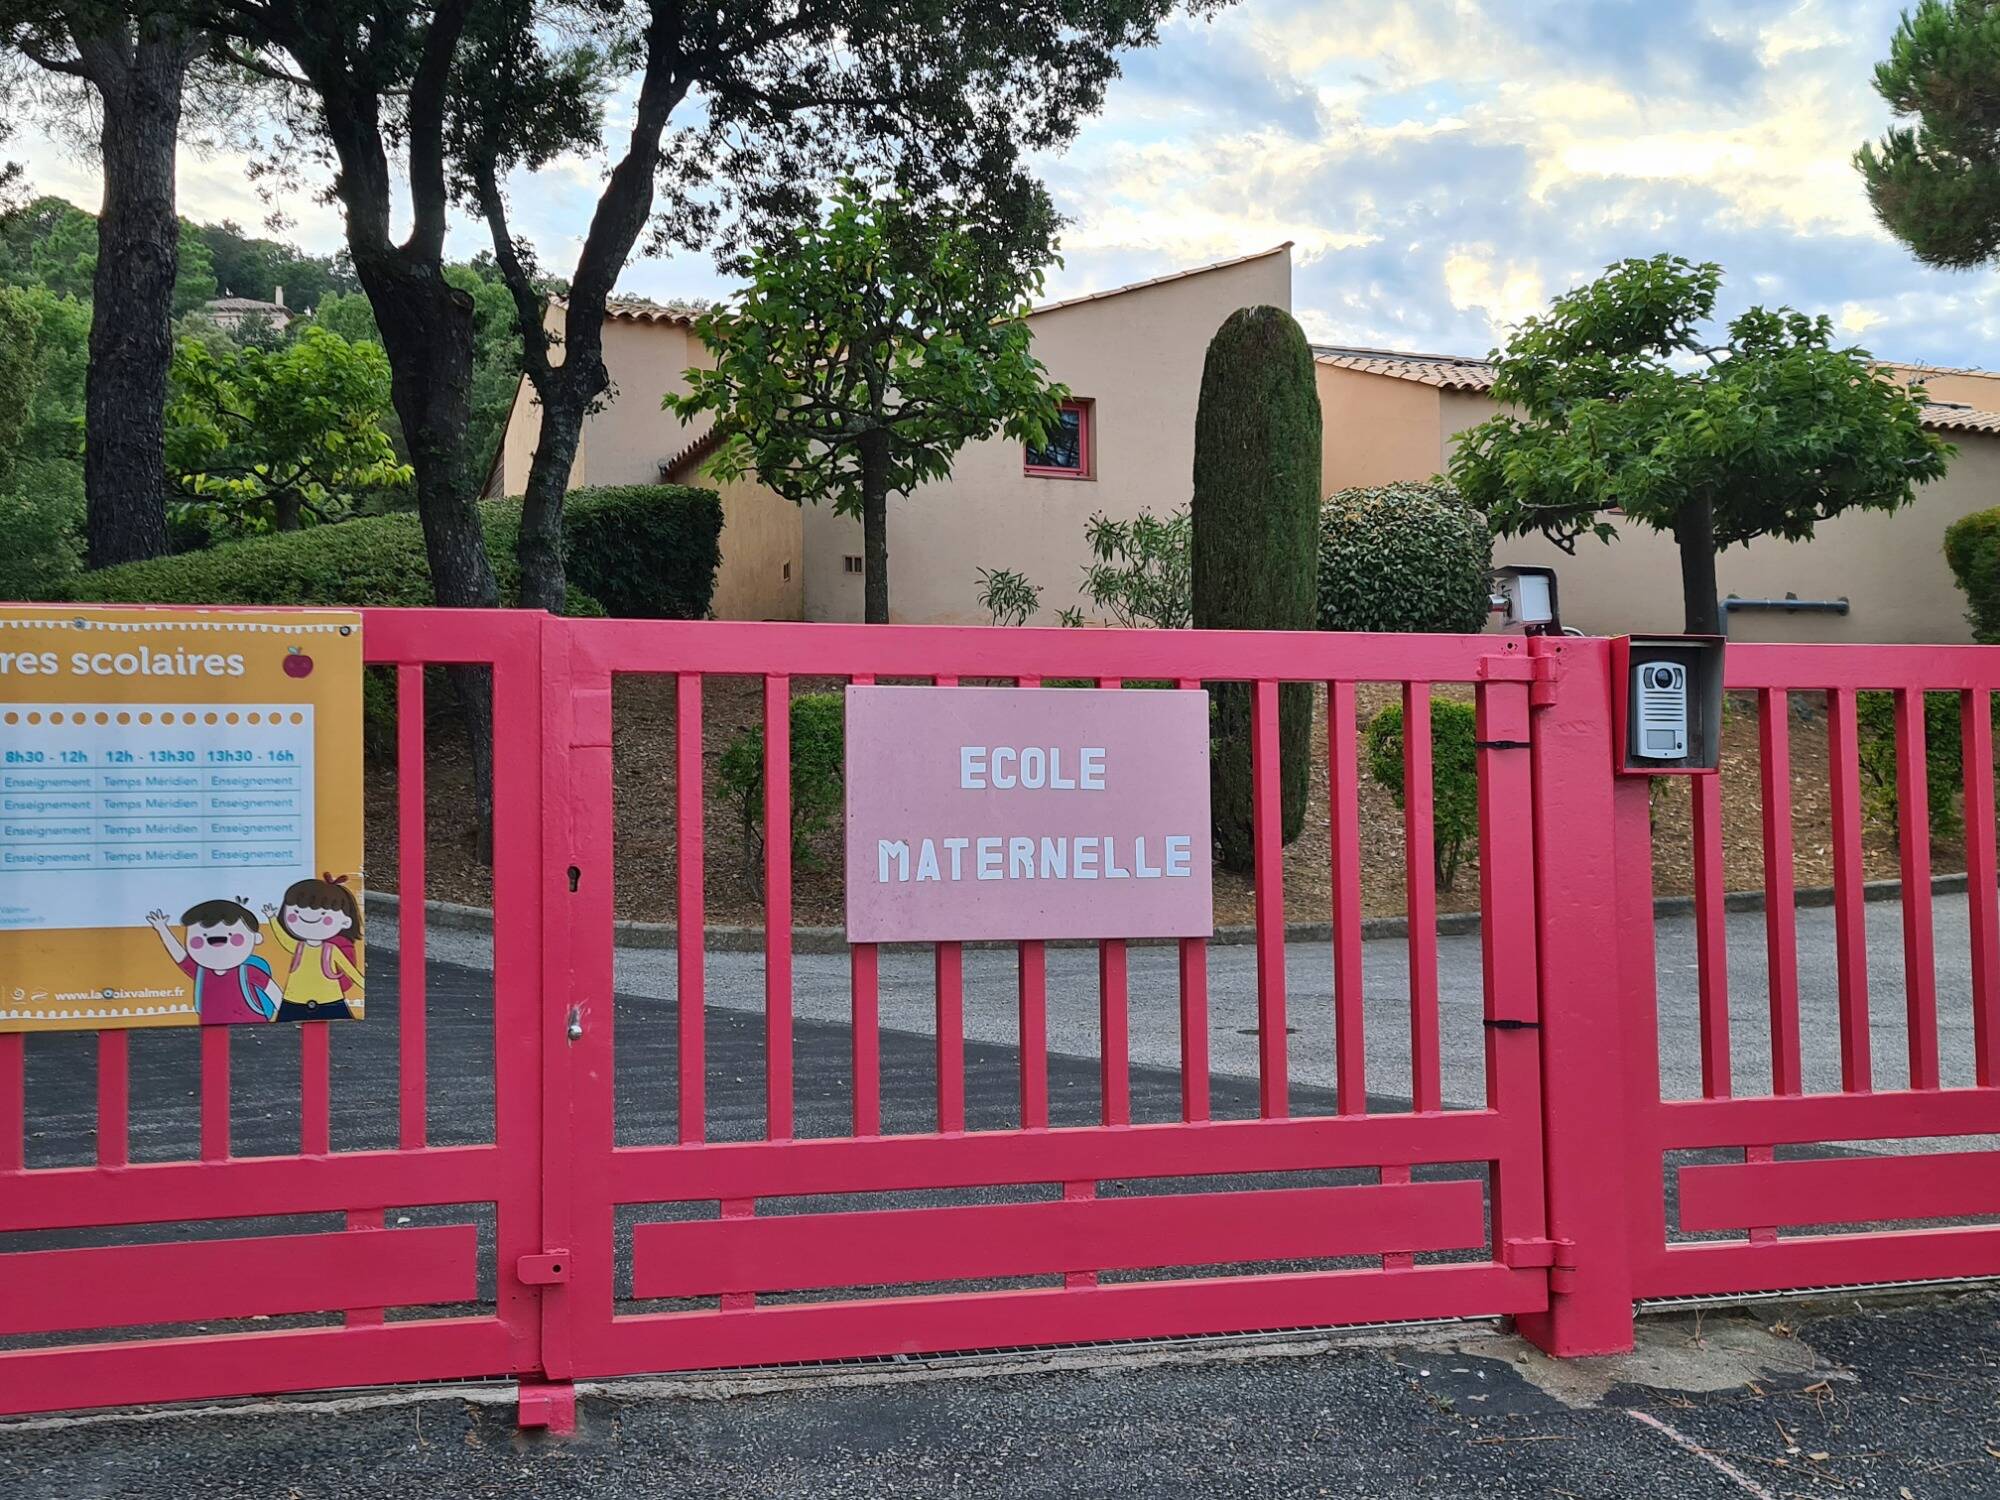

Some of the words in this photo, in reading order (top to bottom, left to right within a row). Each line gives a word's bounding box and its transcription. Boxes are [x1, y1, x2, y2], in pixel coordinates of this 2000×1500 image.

[71, 646, 245, 676] scolaires
[5, 751, 44, 763] 8h30
[59, 750, 88, 763] 12h
[105, 750, 133, 763] 12h
[149, 750, 195, 763] 13h30
[207, 750, 252, 762] 13h30
[268, 750, 294, 761] 16h
[960, 746, 1106, 790] ECOLE
[4, 777, 91, 789] Enseignement
[103, 776, 141, 788] Temps
[210, 775, 293, 788] Enseignement
[4, 800, 91, 812] Enseignement
[103, 799, 141, 812] Temps
[210, 798, 293, 809] Enseignement
[4, 825, 91, 838] Enseignement
[103, 824, 141, 837] Temps
[210, 822, 293, 835] Enseignement
[4, 852, 91, 866] Enseignement
[103, 851, 141, 864] Temps
[210, 848, 293, 861] Enseignement
[878, 836, 1192, 883] MATERNELLE
[55, 987, 186, 1001] www.laoixvalmer.fr
